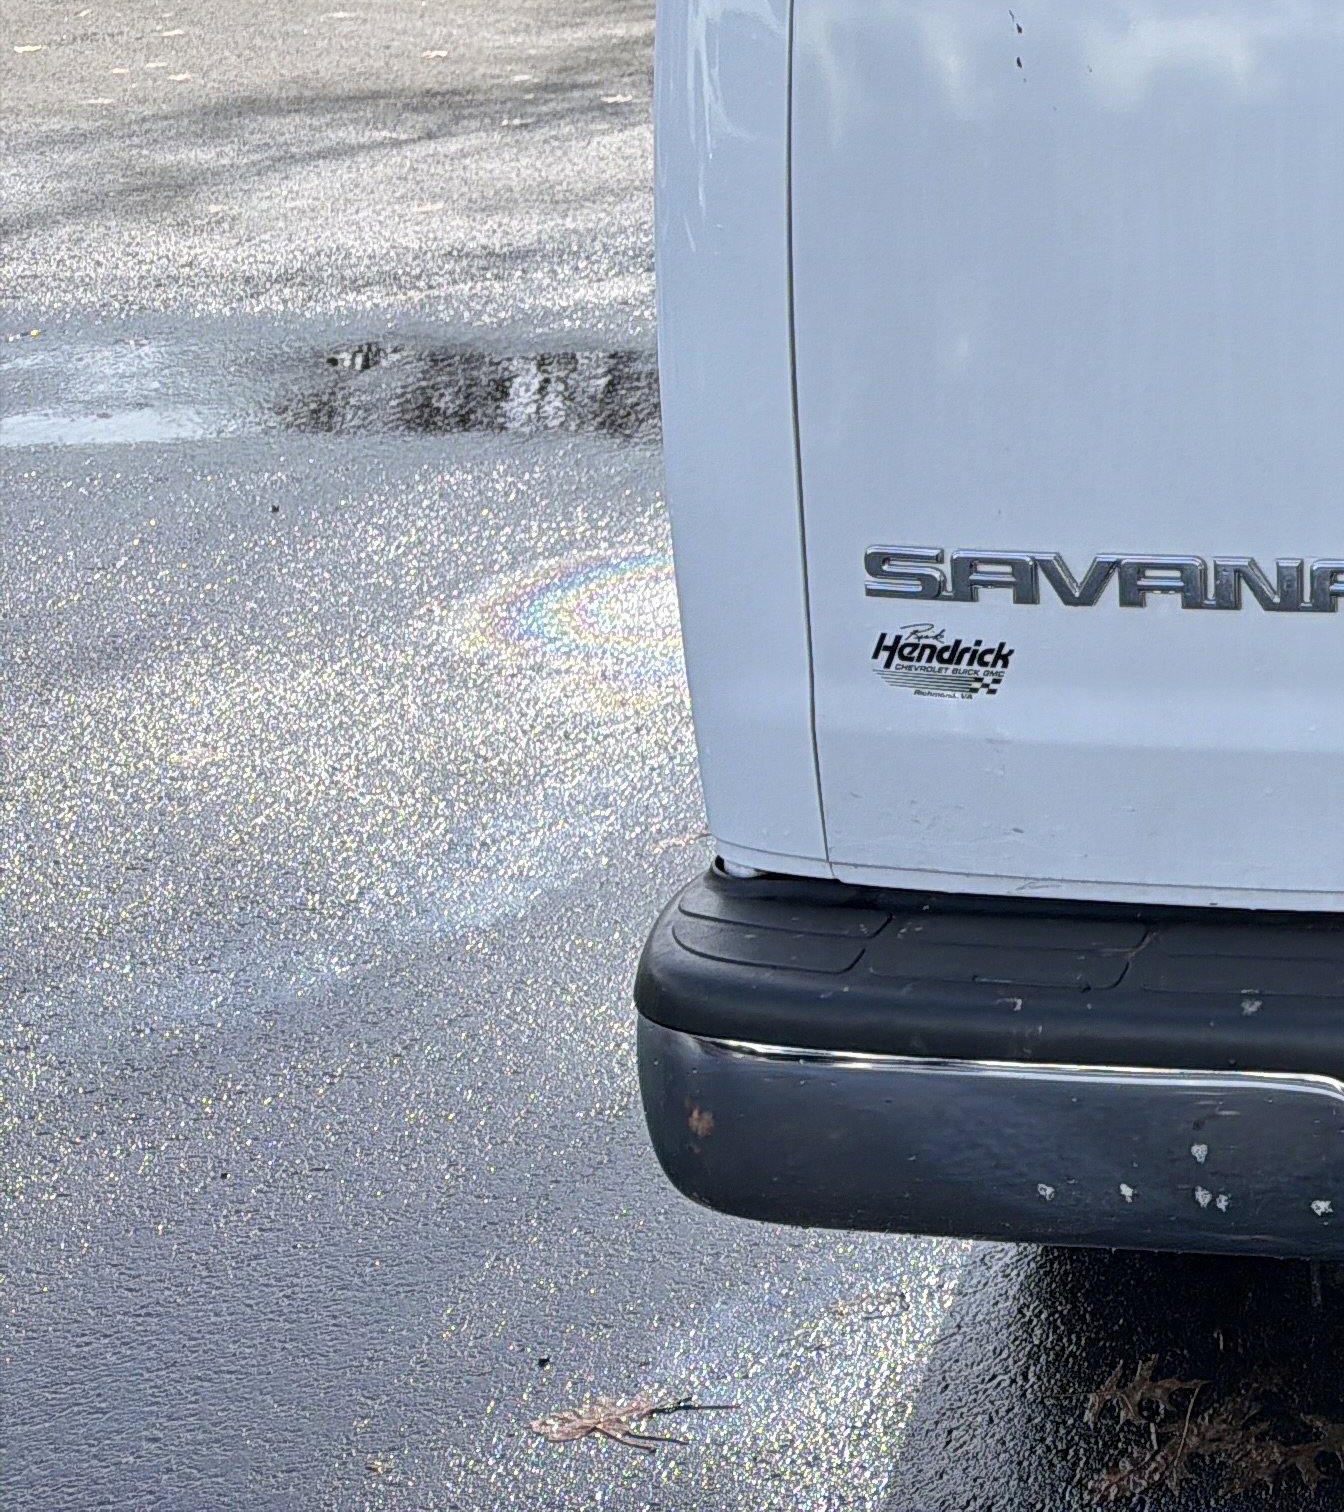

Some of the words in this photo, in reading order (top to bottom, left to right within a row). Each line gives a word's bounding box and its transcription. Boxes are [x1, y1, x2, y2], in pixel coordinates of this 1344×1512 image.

[871, 632, 1015, 670] Hendrick
[894, 663, 950, 674] CHEVROLET
[951, 667, 981, 677] BUICK
[982, 670, 1006, 678] GMC
